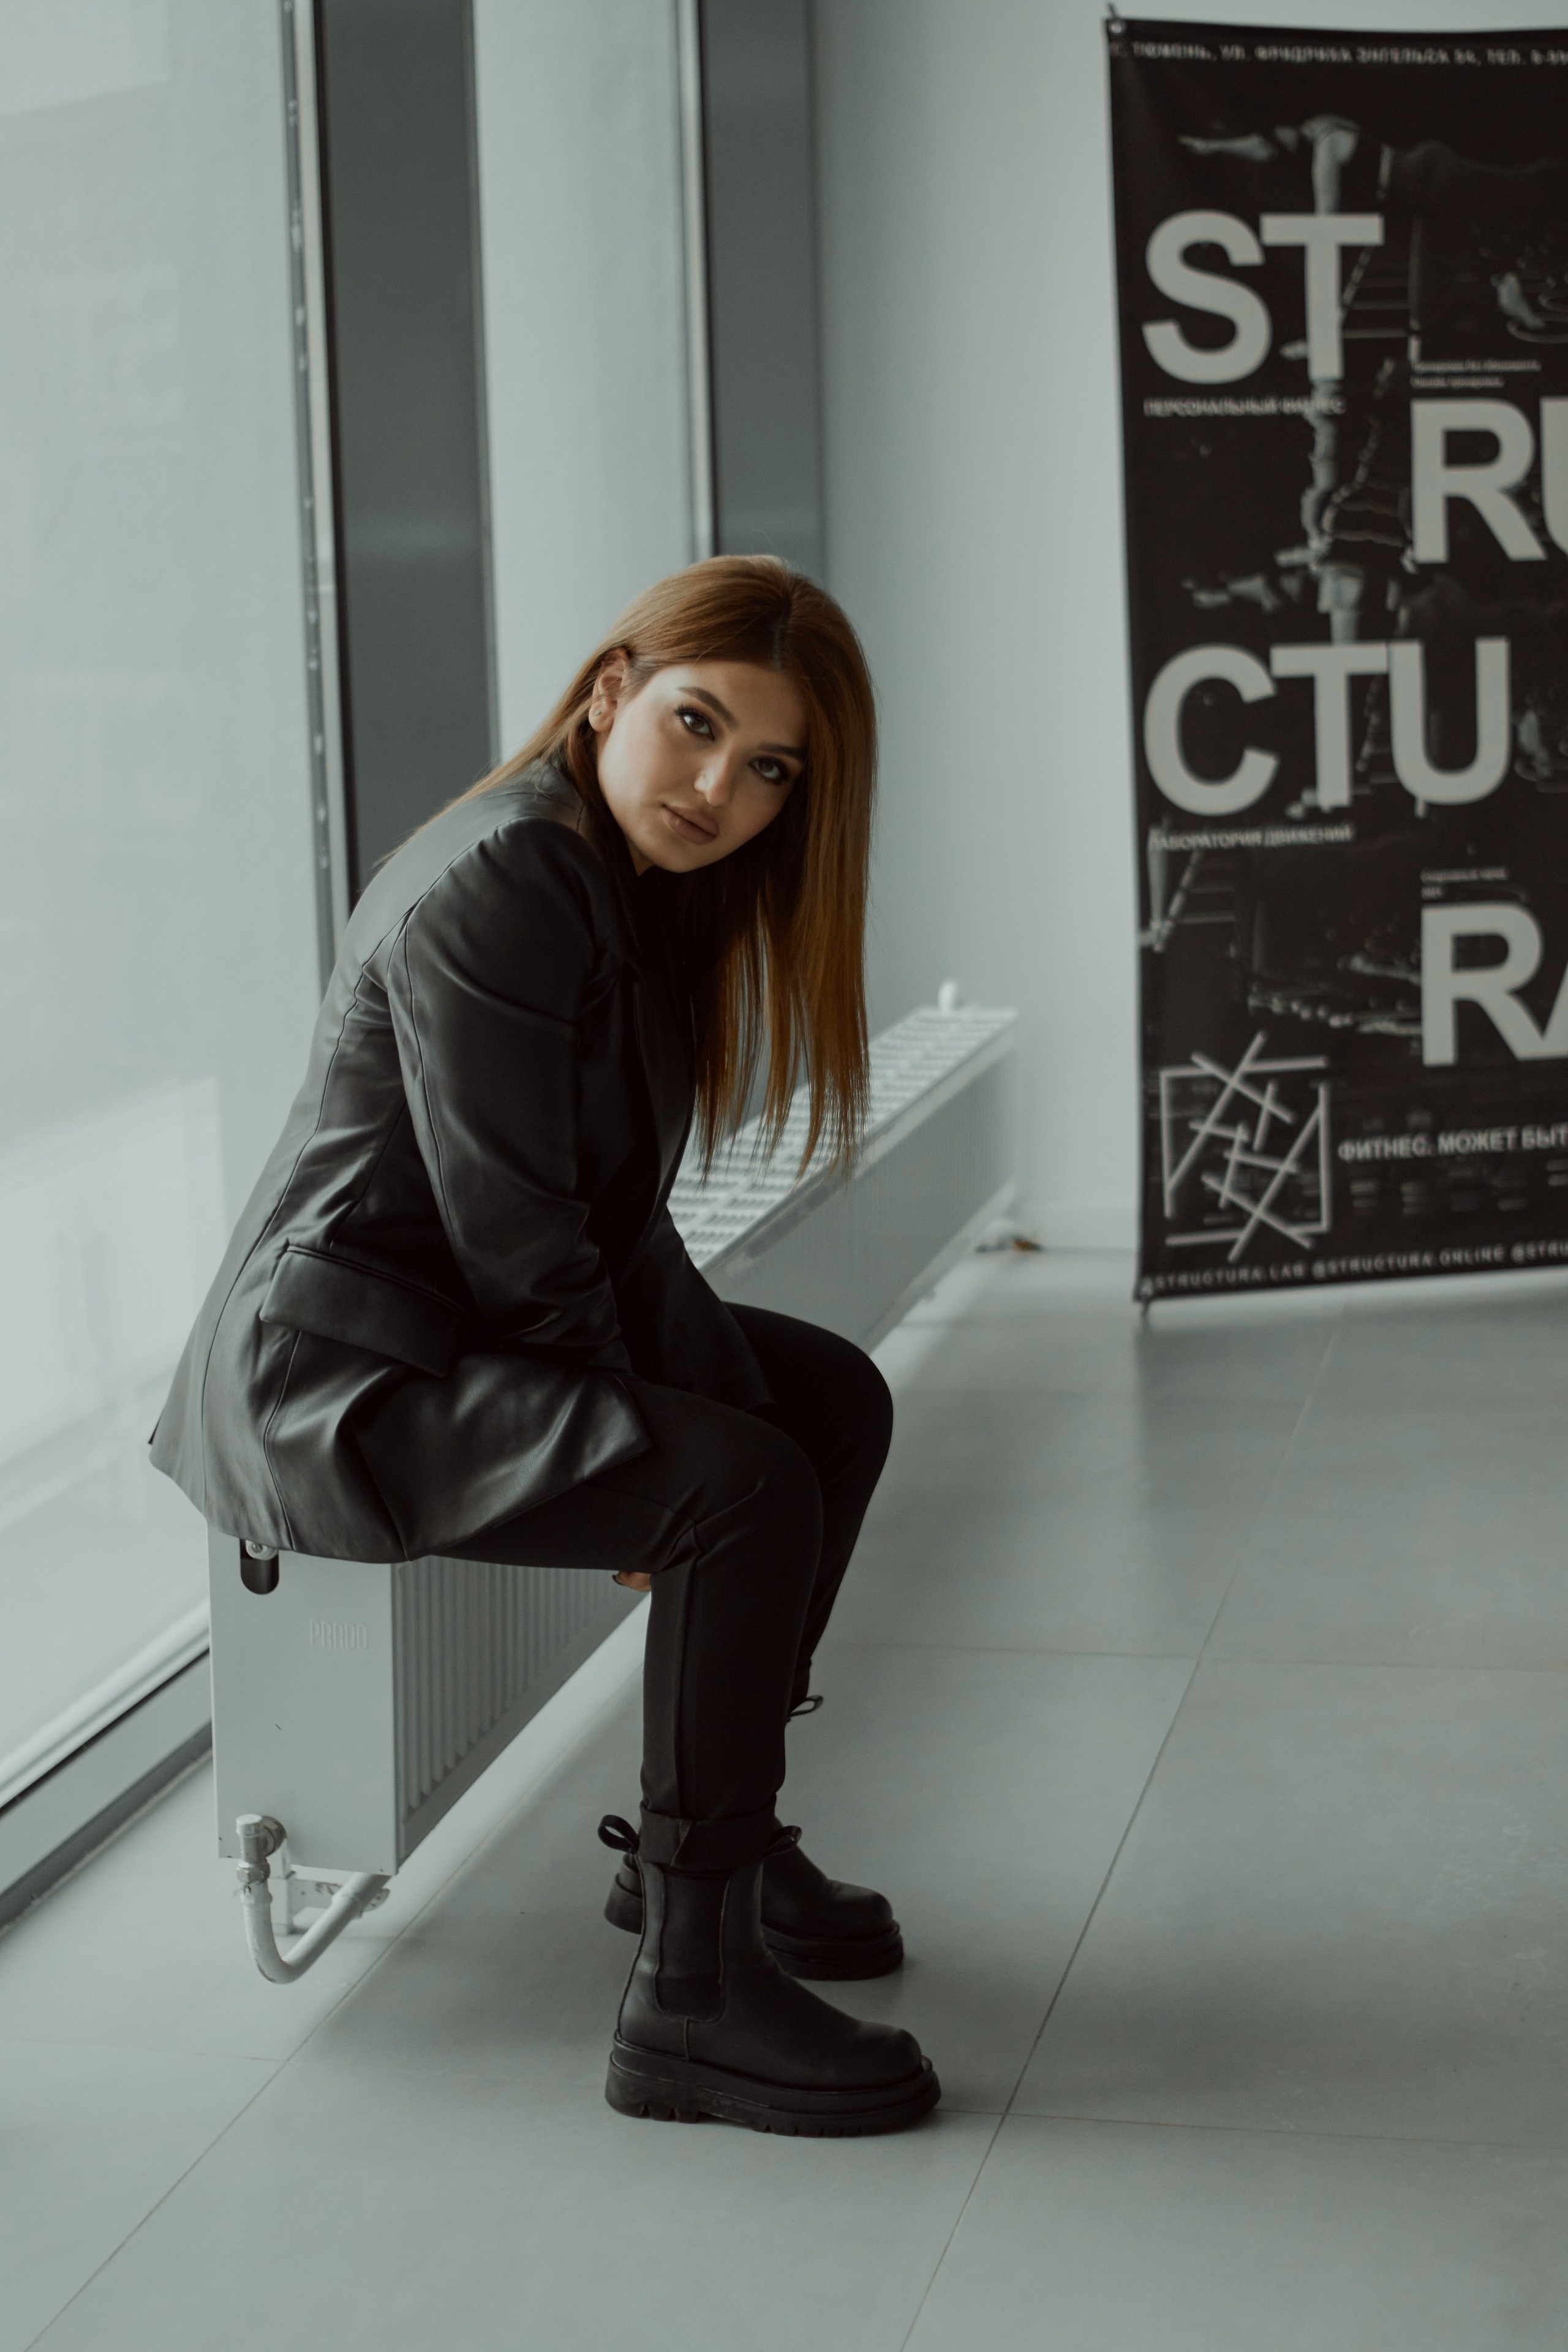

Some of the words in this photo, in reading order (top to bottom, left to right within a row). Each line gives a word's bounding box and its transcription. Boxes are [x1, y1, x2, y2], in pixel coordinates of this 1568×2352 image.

[1141, 209, 1384, 385] ST
[1410, 396, 1568, 564] R
[1144, 638, 1511, 815] CTU
[1438, 1126, 1518, 1156] МОЖЕТ
